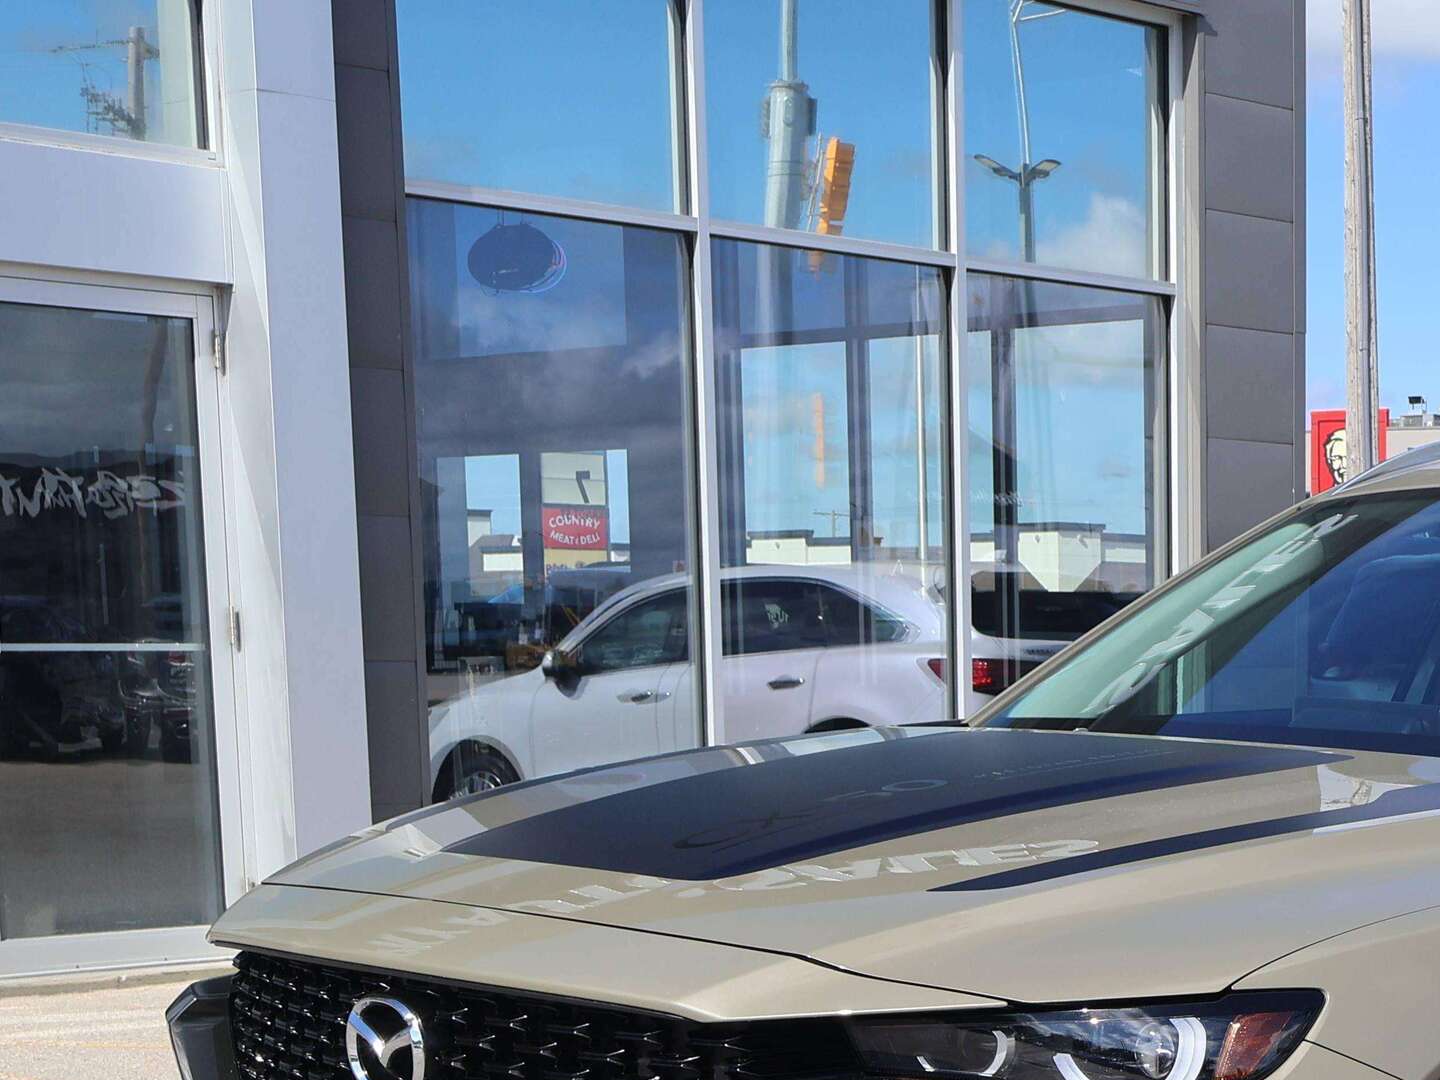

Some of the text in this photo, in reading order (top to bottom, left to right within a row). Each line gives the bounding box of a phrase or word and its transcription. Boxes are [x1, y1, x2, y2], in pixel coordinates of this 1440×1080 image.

[548, 513, 601, 530] COUNTRY
[549, 529, 575, 545] MEAT
[579, 531, 601, 545] DELI
